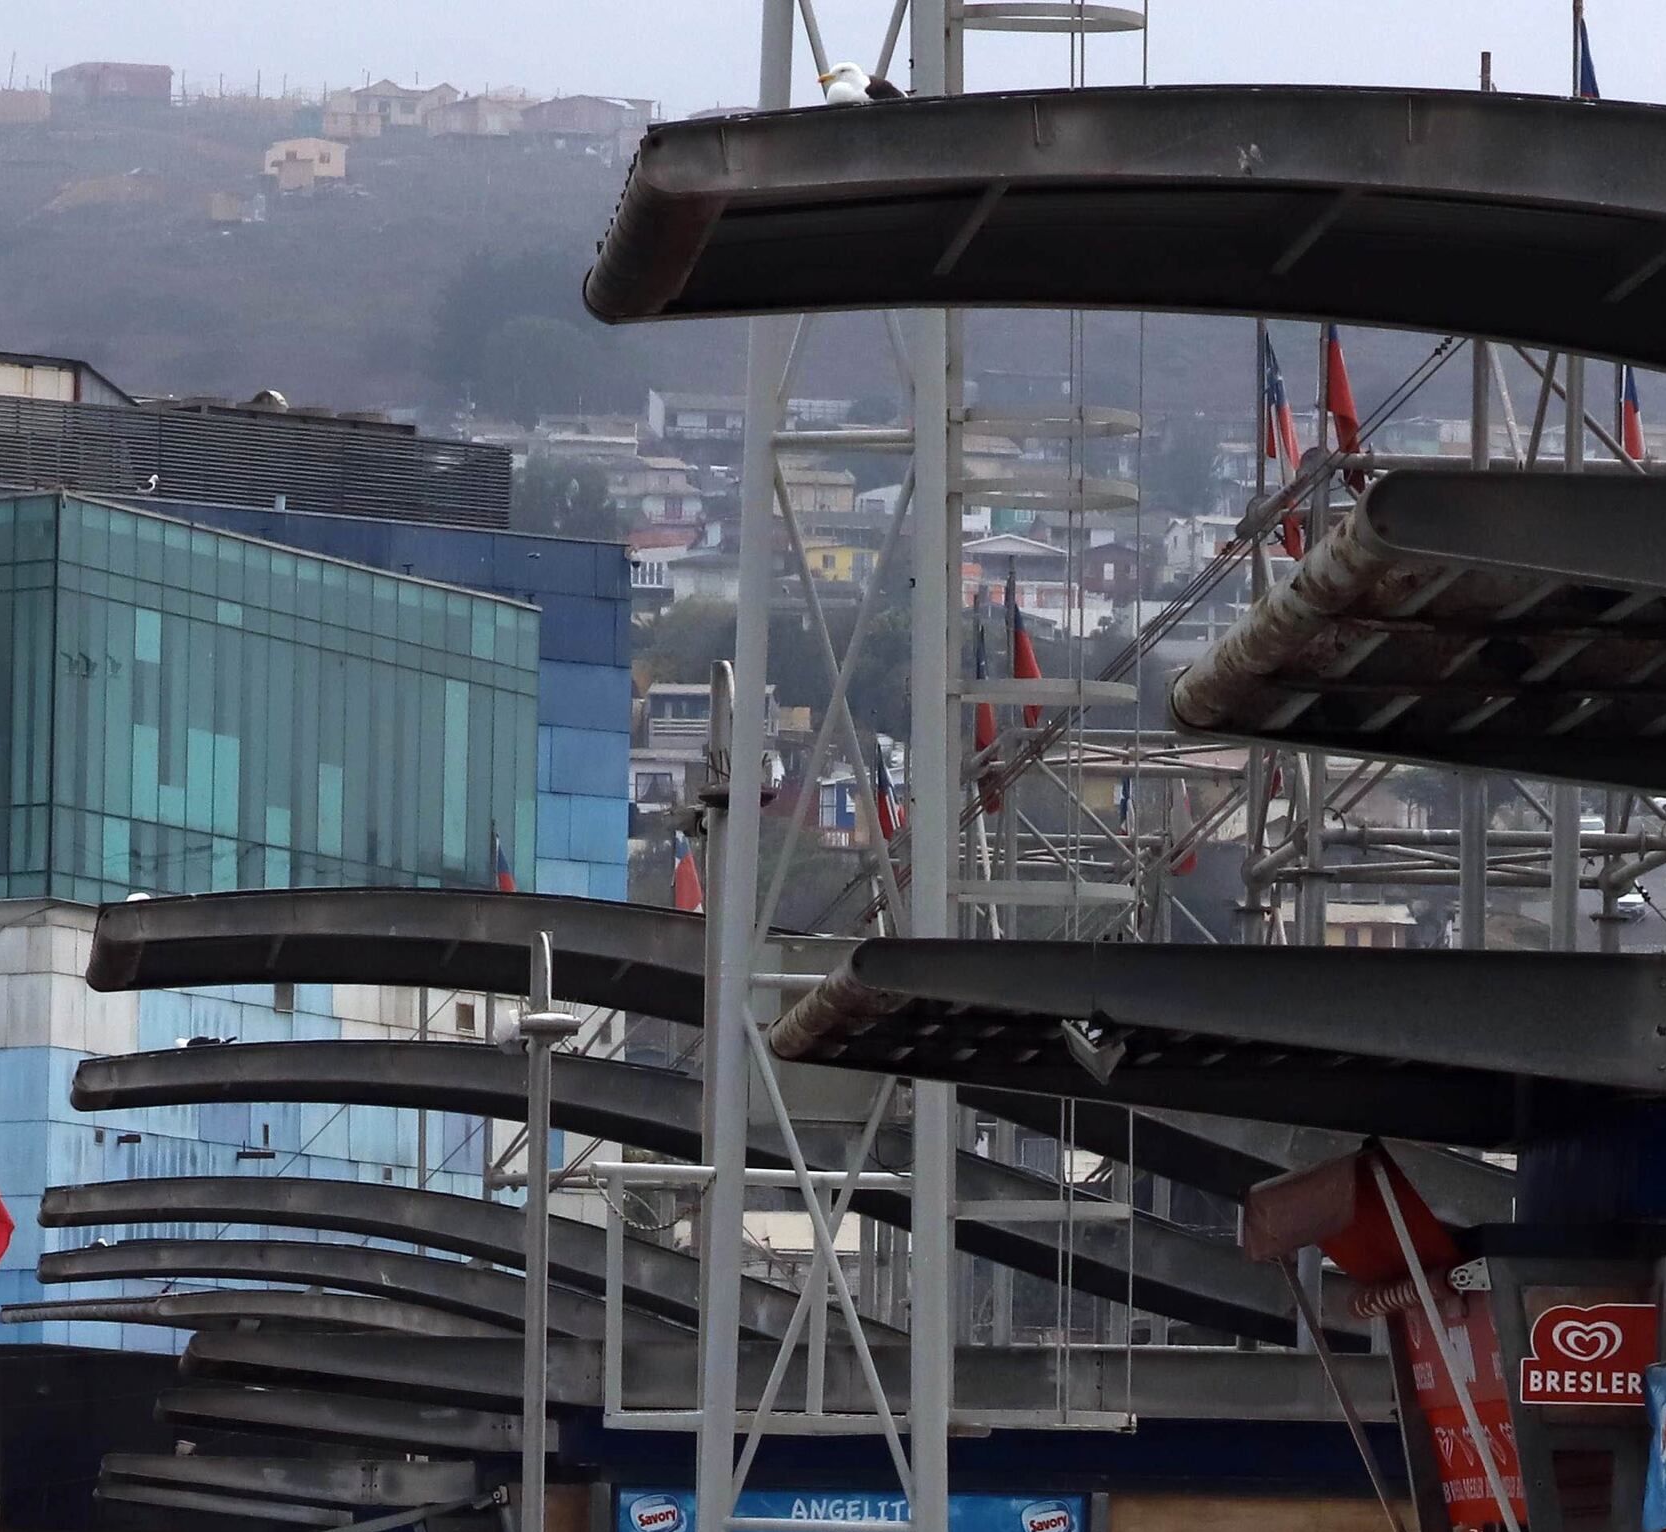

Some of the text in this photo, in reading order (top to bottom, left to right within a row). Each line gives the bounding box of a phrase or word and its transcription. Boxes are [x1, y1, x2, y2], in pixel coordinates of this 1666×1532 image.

[1529, 1370, 1643, 1395] BRESLER
[638, 1507, 678, 1528] Savory
[791, 1498, 912, 1521] ANGELIT
[1029, 1512, 1068, 1532] Savory
